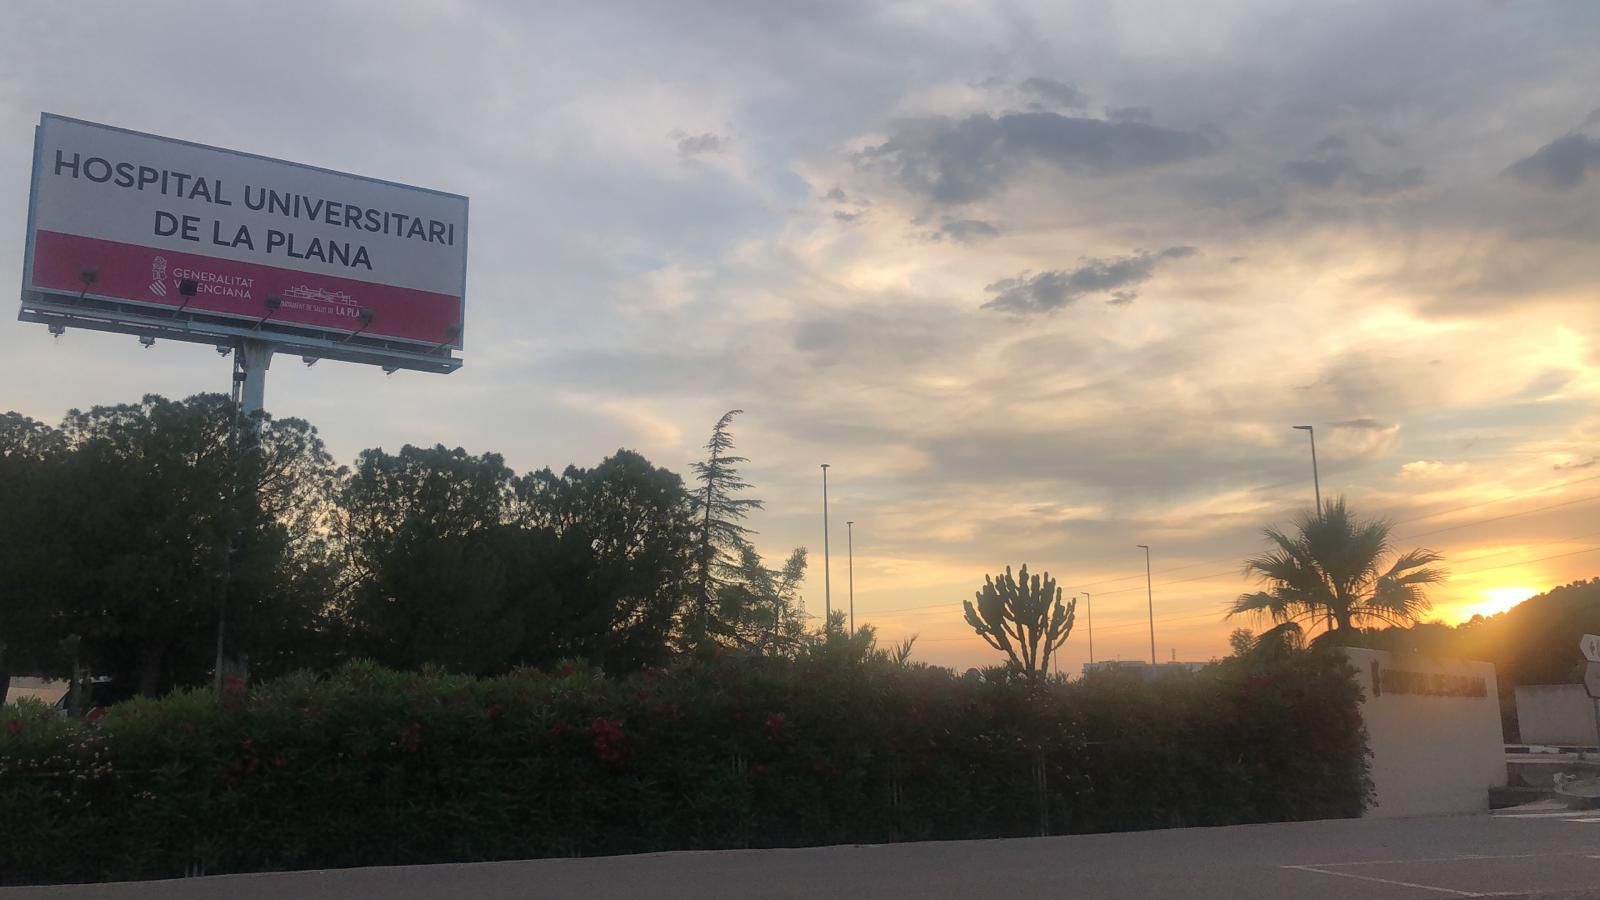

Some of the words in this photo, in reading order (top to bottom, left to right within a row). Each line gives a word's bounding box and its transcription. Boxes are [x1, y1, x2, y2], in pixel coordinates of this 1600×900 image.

[55, 150, 232, 206] HOSPITAL
[244, 185, 454, 246] UNIVERSITARI
[154, 210, 200, 241] DE
[213, 220, 254, 250] LA
[266, 230, 373, 270] PLANA
[173, 268, 255, 288] GENERALITAT
[173, 279, 251, 299] VENCIANA
[335, 306, 345, 316] LA
[346, 308, 360, 318] PLA
